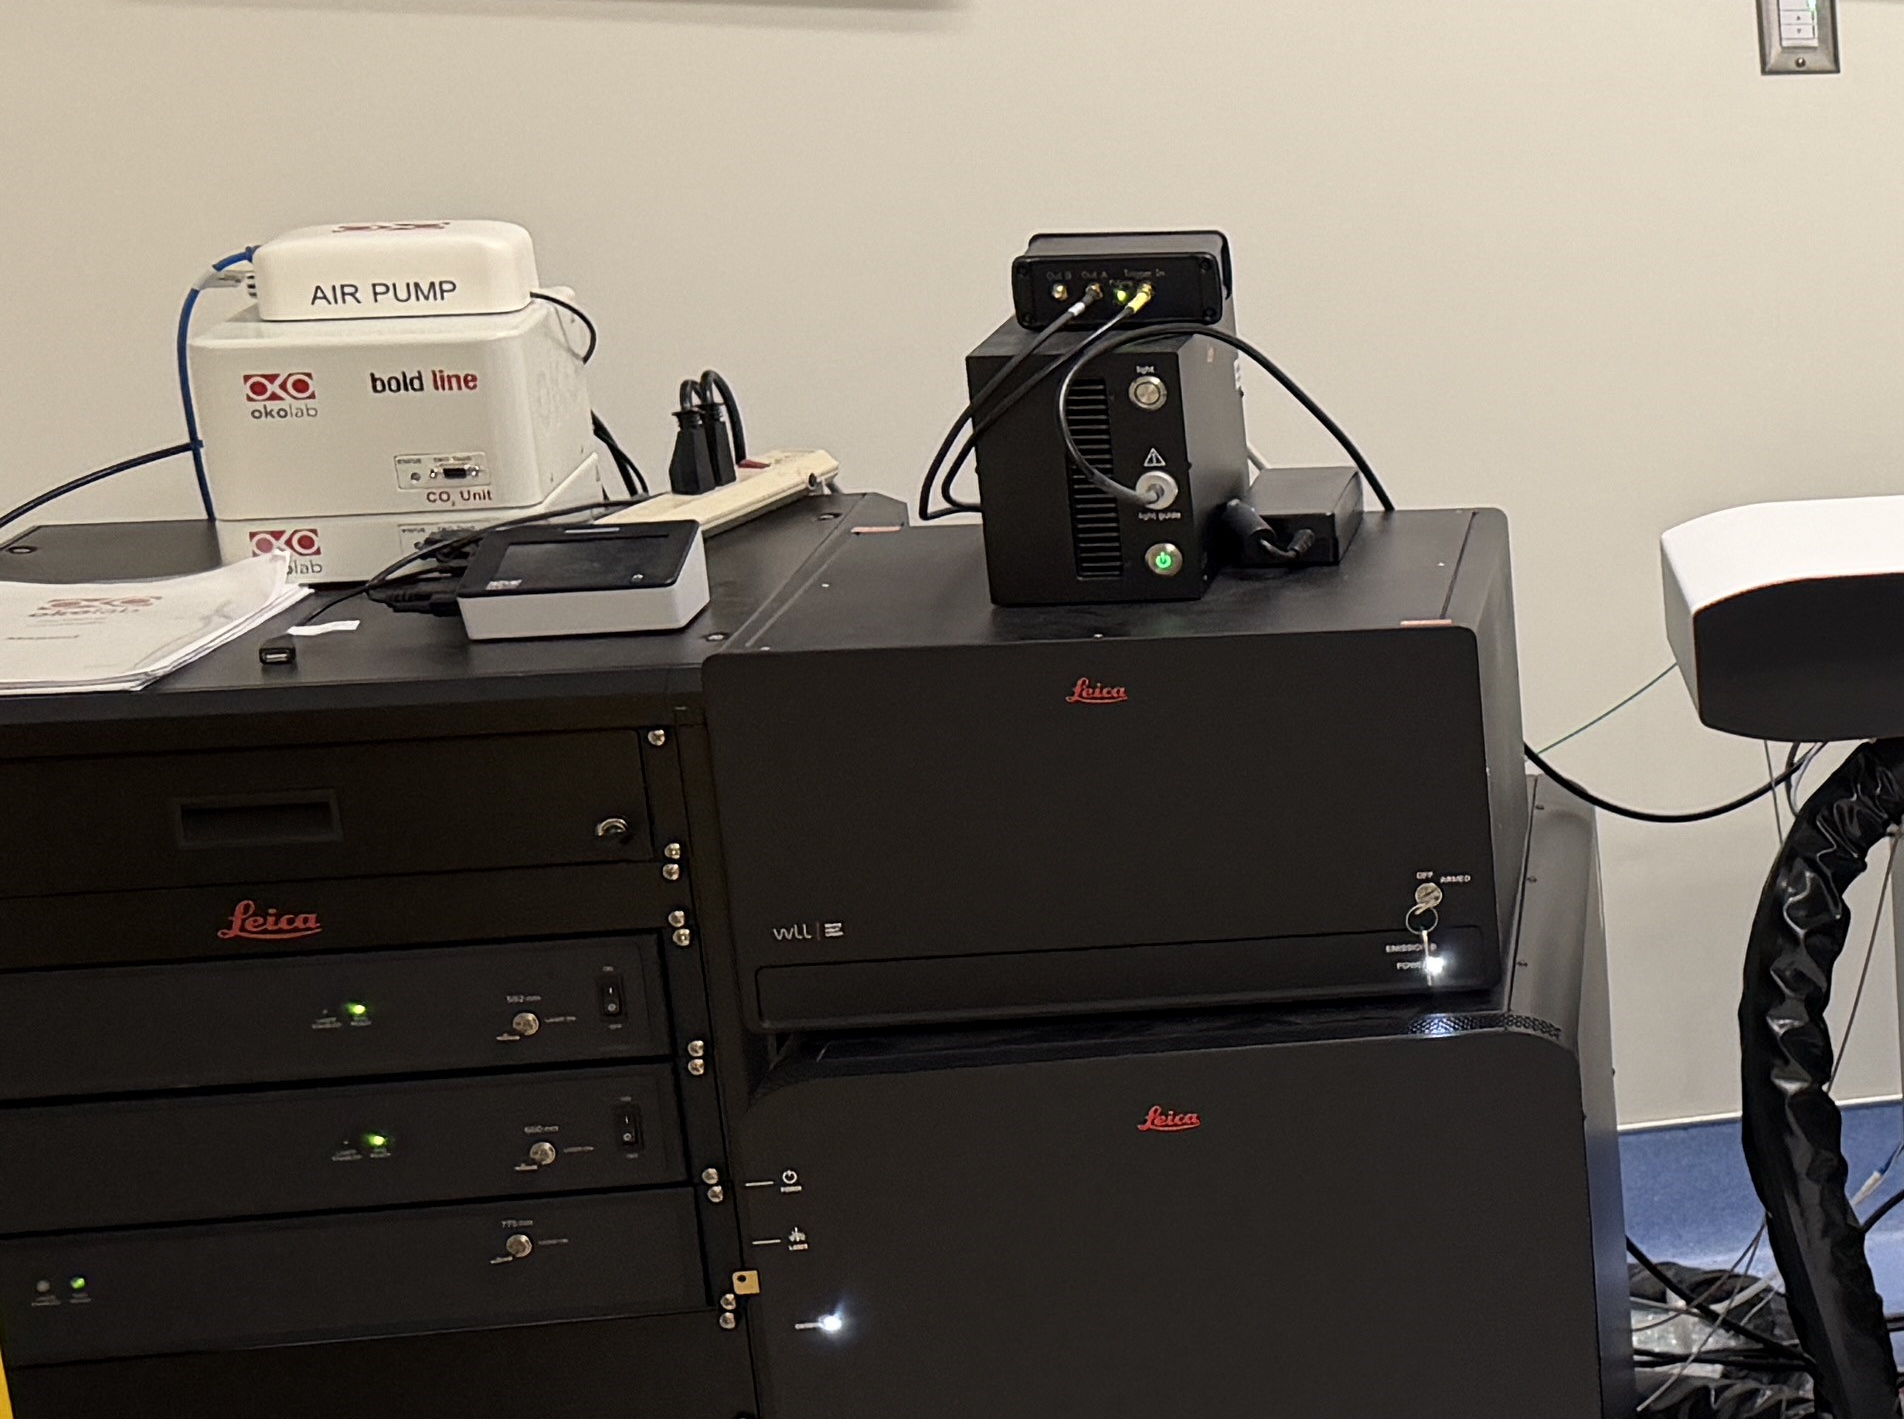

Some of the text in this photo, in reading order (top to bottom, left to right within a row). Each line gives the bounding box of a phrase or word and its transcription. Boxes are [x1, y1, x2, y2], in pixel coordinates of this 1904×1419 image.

[311, 279, 458, 308] AIR PUMP
[369, 369, 478, 393] bold line
[250, 403, 318, 420] okolab
[459, 489, 493, 501] Unit
[1065, 678, 1128, 704] Leica
[217, 898, 322, 941] Leica
[1137, 1104, 1202, 1132] Leica
